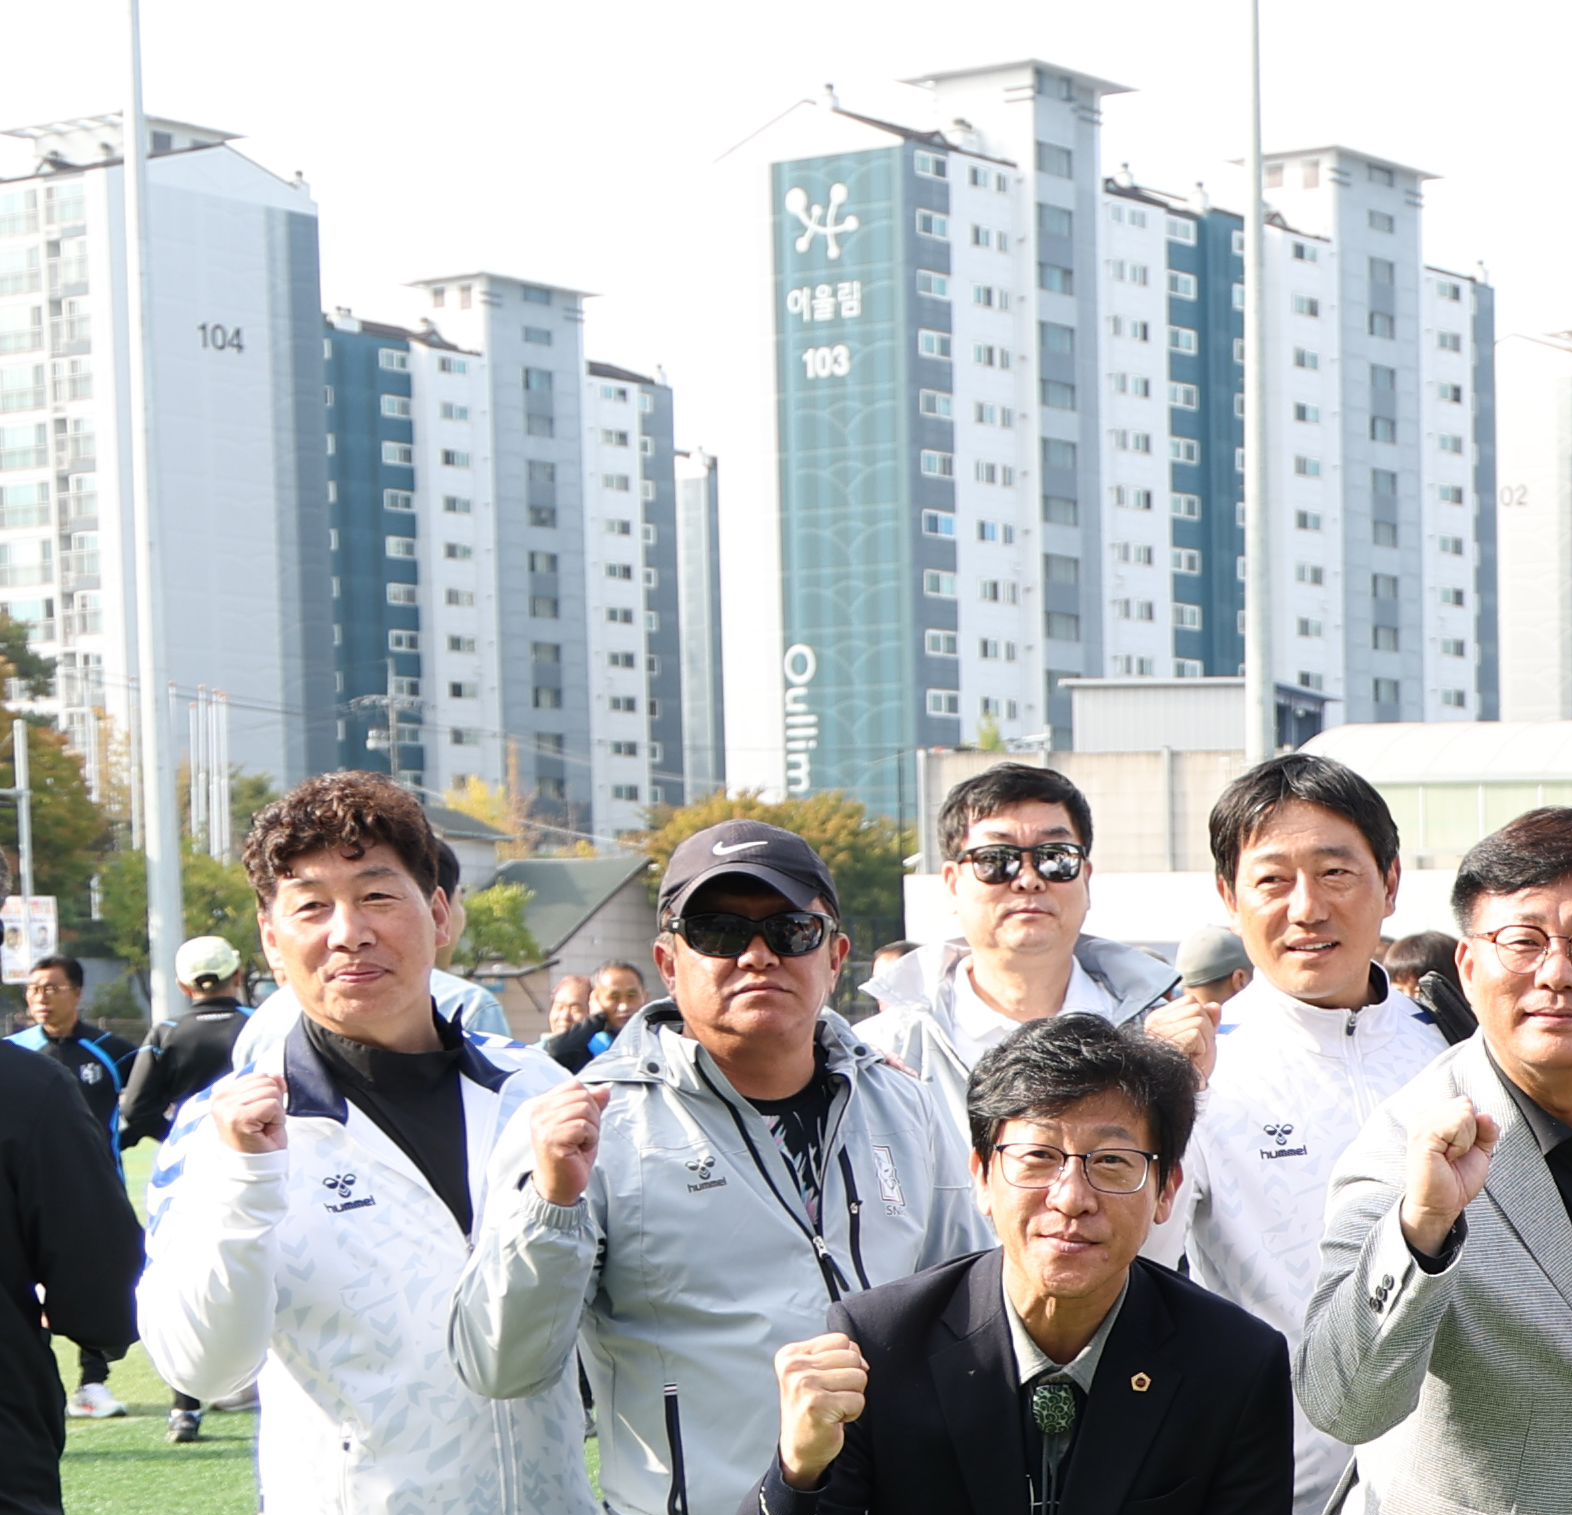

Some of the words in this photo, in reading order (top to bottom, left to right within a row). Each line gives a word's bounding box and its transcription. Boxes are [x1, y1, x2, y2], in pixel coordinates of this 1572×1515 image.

[786, 280, 861, 323] 어울림
[197, 322, 245, 354] 104
[802, 344, 850, 379] 103
[783, 643, 819, 794] Oullim
[1259, 1143, 1308, 1159] hummel
[687, 1176, 728, 1193] hummel
[323, 1194, 377, 1213] hummel
